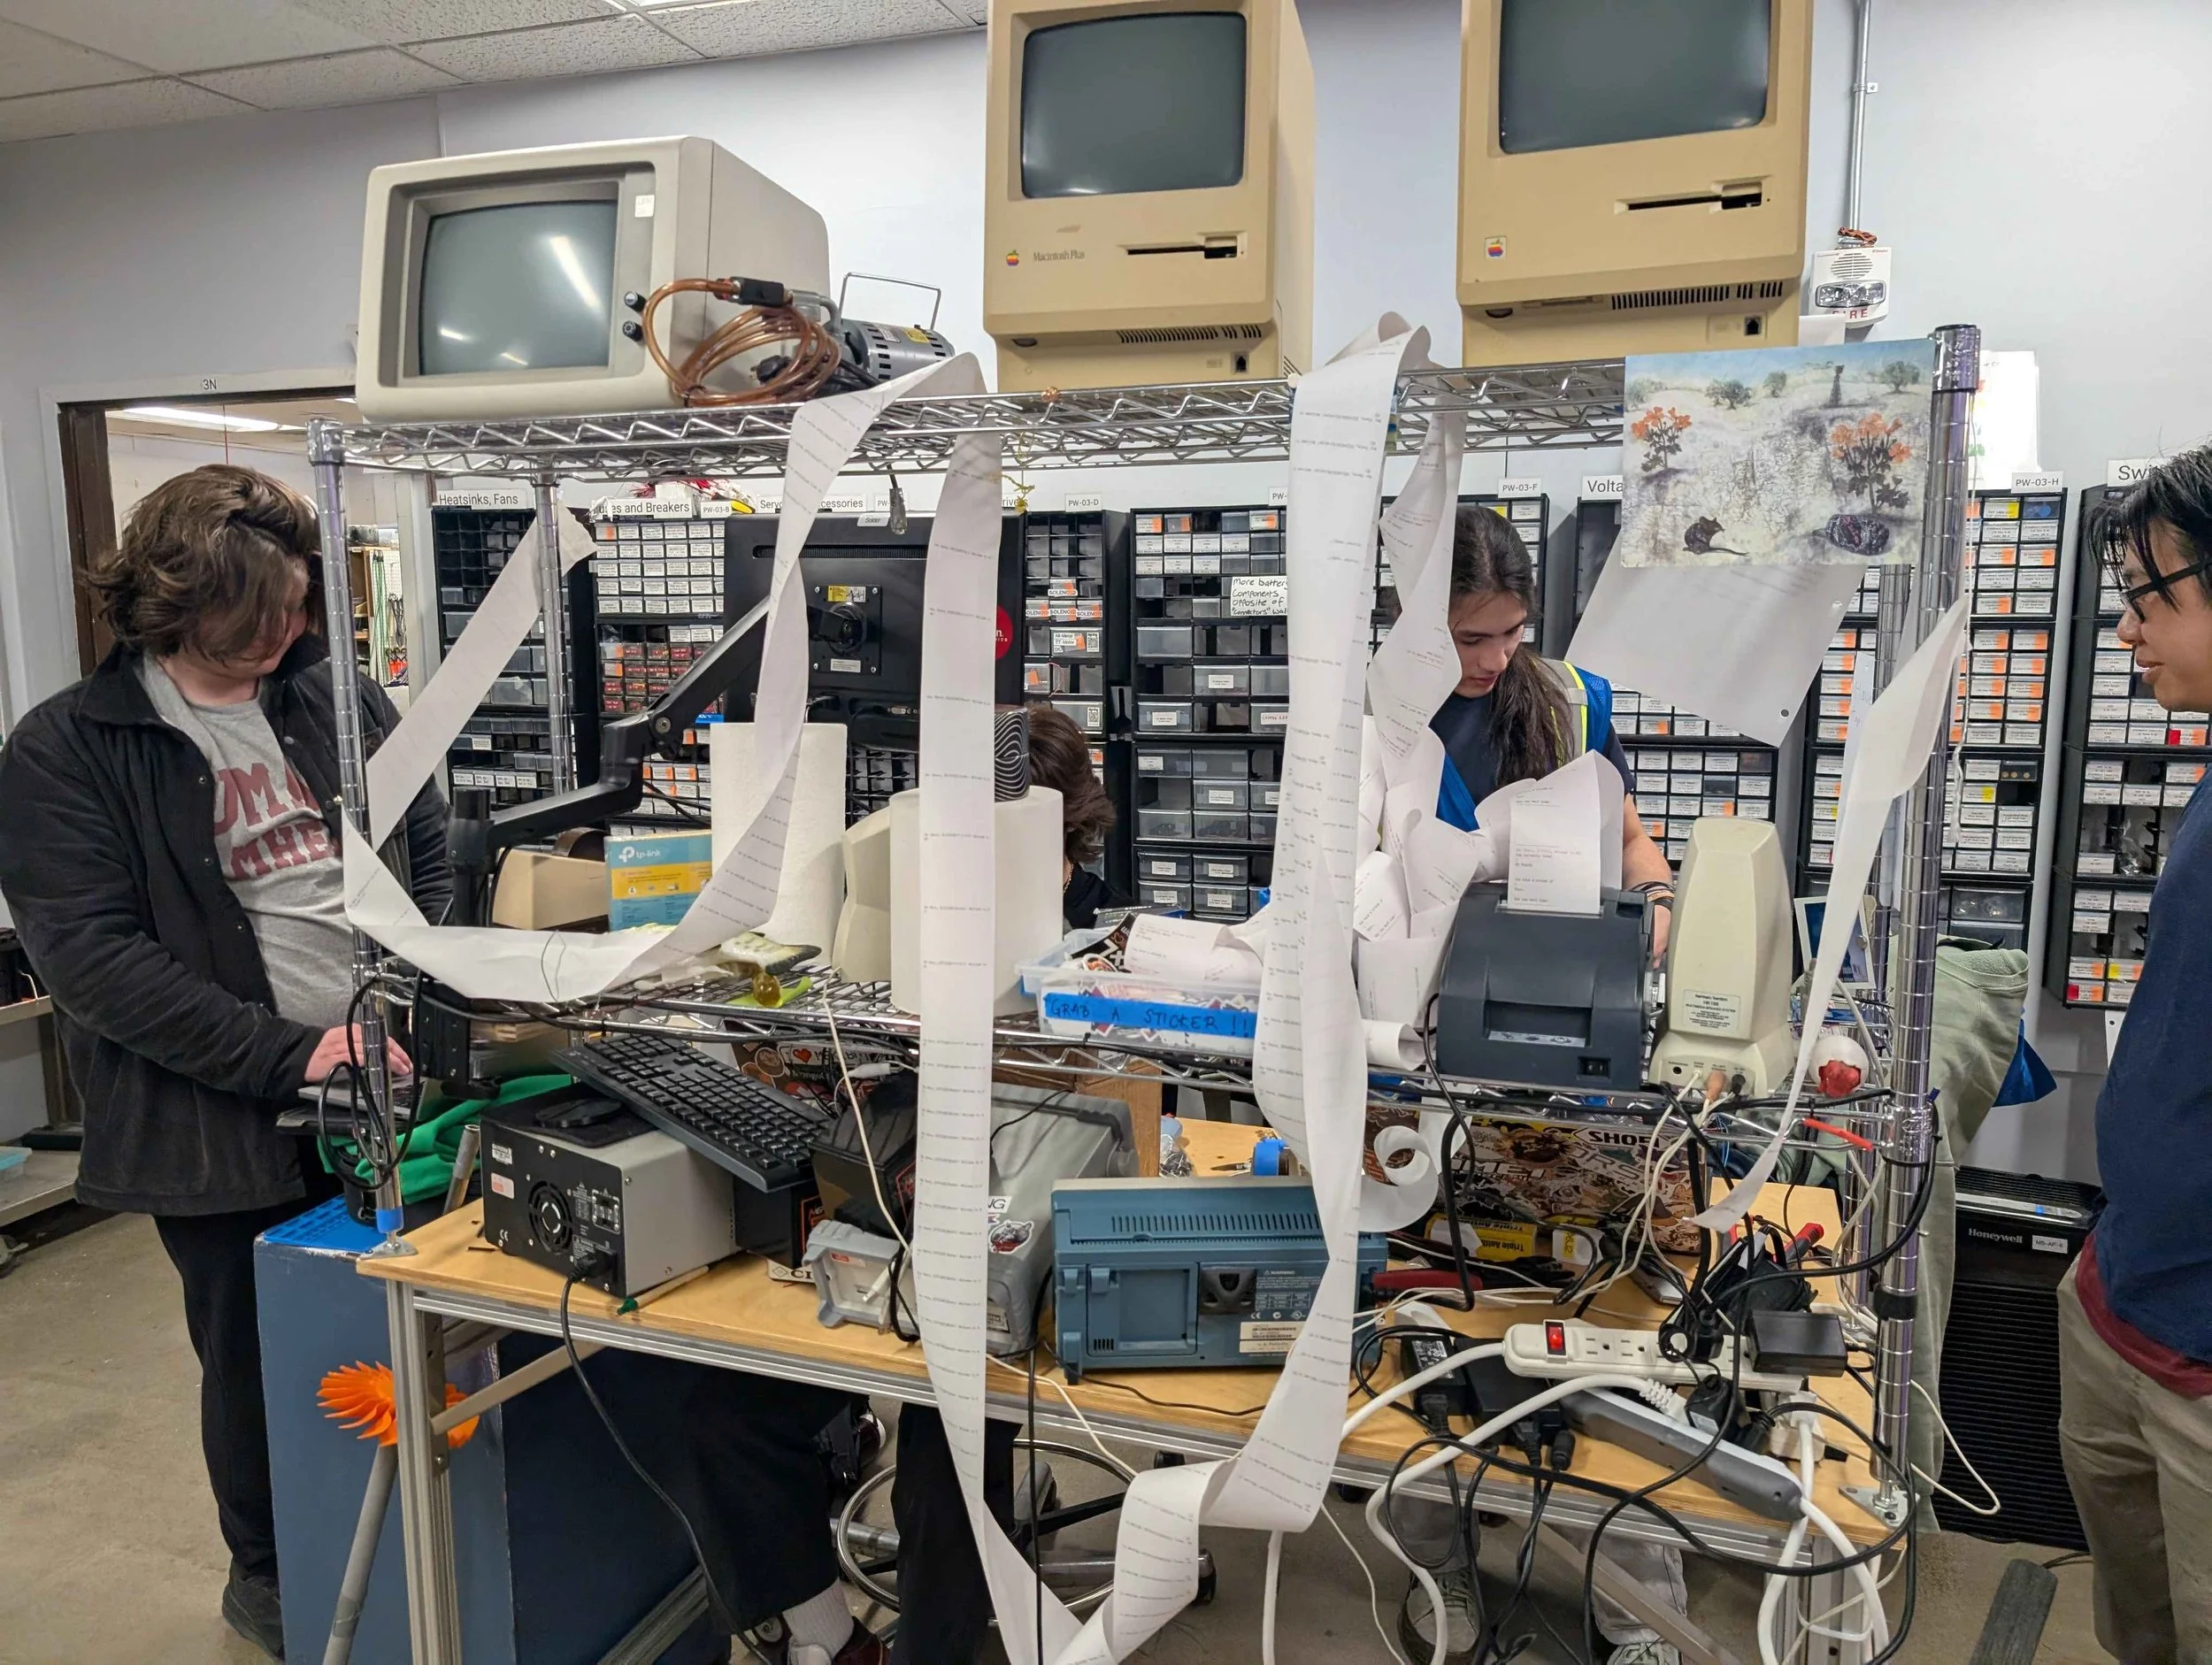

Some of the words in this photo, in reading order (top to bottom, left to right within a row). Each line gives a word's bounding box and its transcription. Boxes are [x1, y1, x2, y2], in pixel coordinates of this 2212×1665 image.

[1033, 249, 1070, 262] Macintosh
[1071, 249, 1086, 260] Plus
[203, 379, 217, 390] 3N
[1502, 483, 1538, 492] PW-03-F
[2016, 478, 2059, 487] PW-03-H
[439, 493, 492, 506] Heatsinks,
[494, 493, 518, 505] Fans
[1068, 498, 1099, 507] PW-03-D
[624, 501, 643, 513] and
[645, 501, 690, 513] Breakers
[703, 505, 730, 514] PW-03-B
[1271, 596, 1285, 608] of
[635, 848, 662, 859] tp-link
[1050, 997, 1091, 1018] GRAB
[1110, 1007, 1121, 1022] A
[1143, 1007, 1219, 1031] STICKER
[1968, 1227, 2024, 1245] Honeywell
